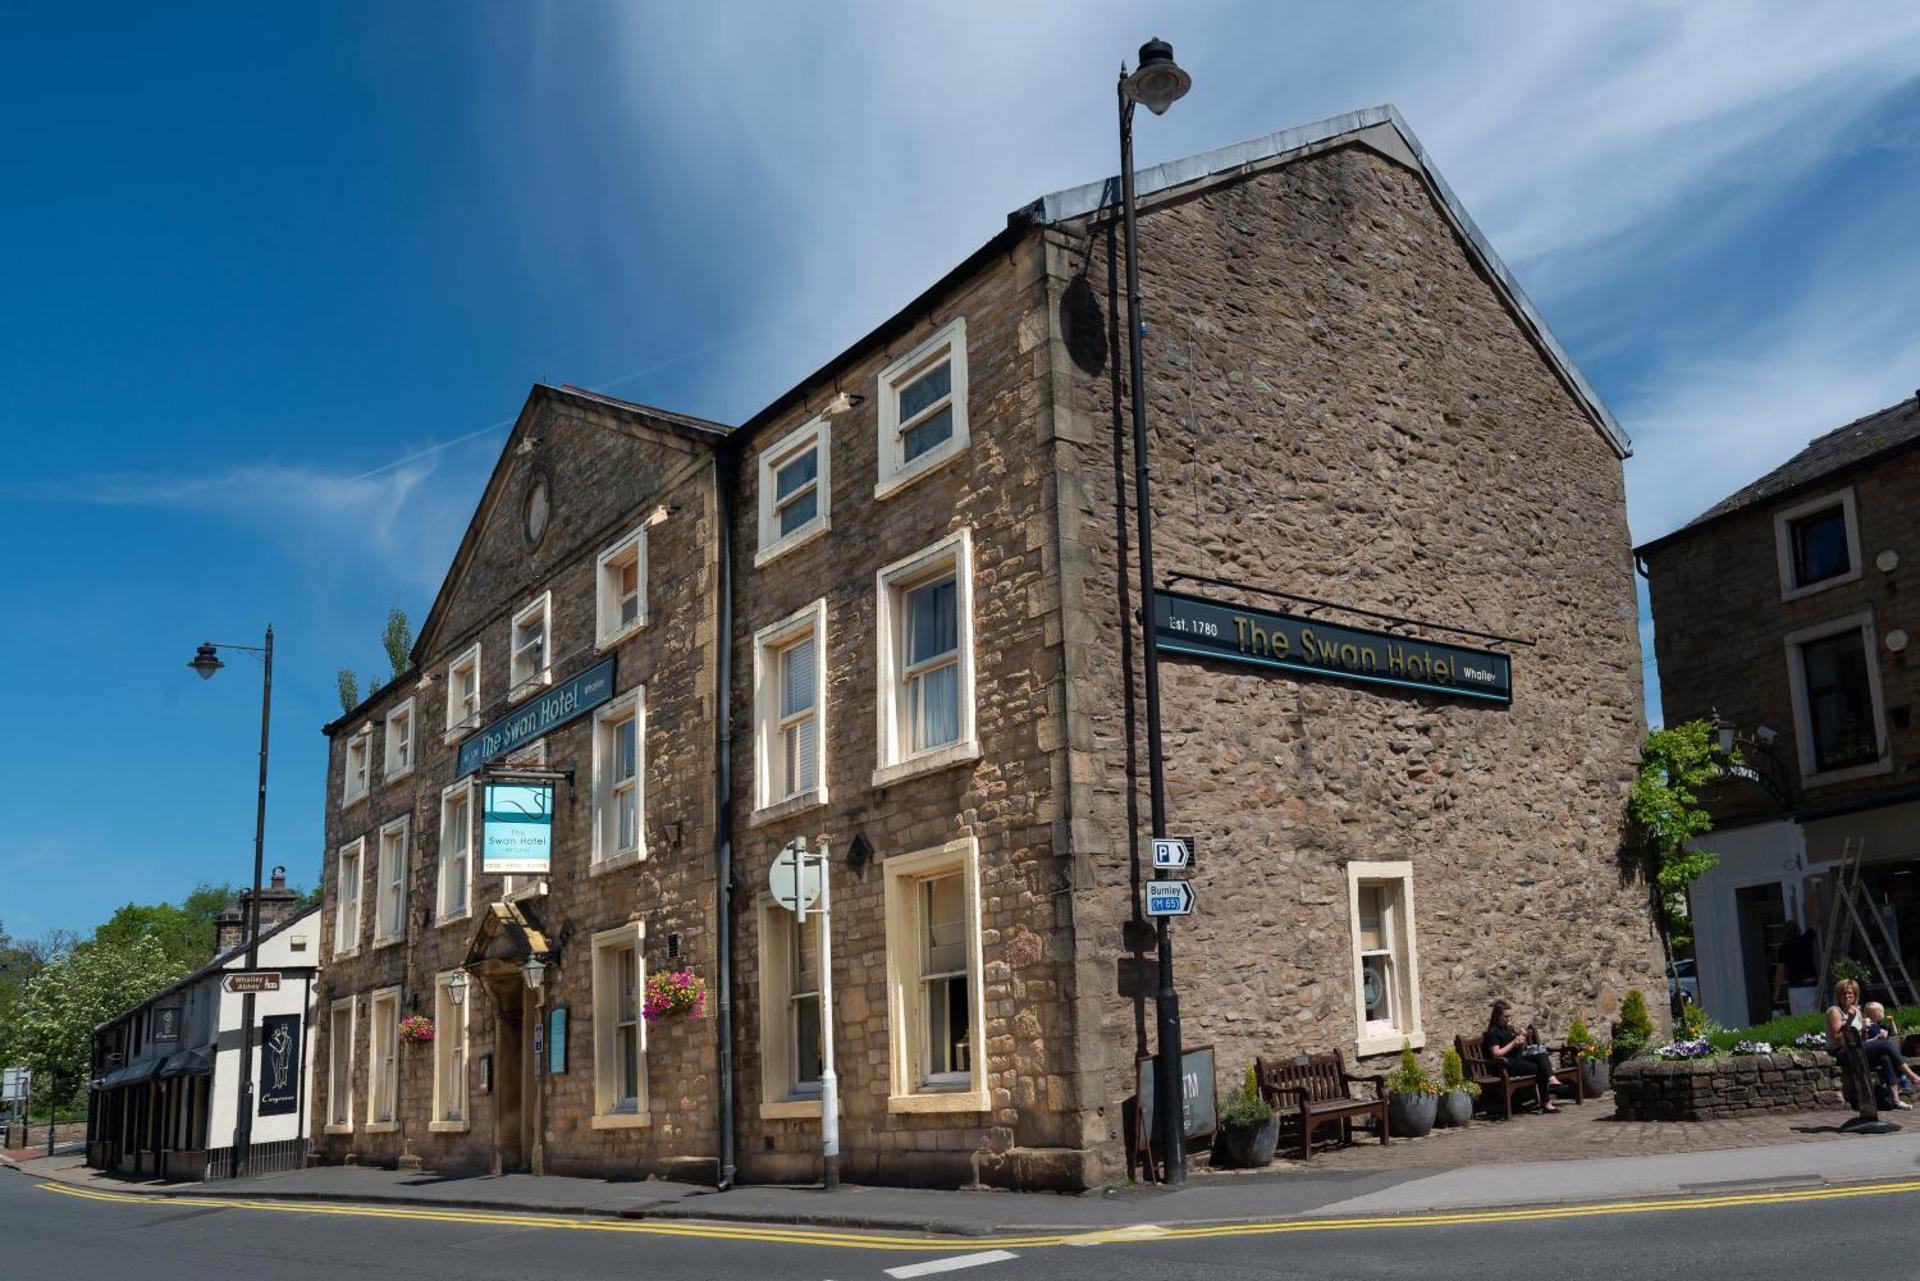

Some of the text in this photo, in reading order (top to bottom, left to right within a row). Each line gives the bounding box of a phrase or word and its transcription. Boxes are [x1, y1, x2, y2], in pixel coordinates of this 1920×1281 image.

[1169, 616, 1496, 684] Est. 1780 The Swan Hotel Whalley
[482, 734, 501, 758] The
[504, 712, 537, 744] Swan
[541, 684, 579, 724] Hotel
[489, 836, 546, 846] Swan Hotel
[1159, 846, 1168, 861] P
[1151, 886, 1181, 896] Burnley
[235, 976, 263, 984] Whalley
[238, 983, 260, 991] Abbey
